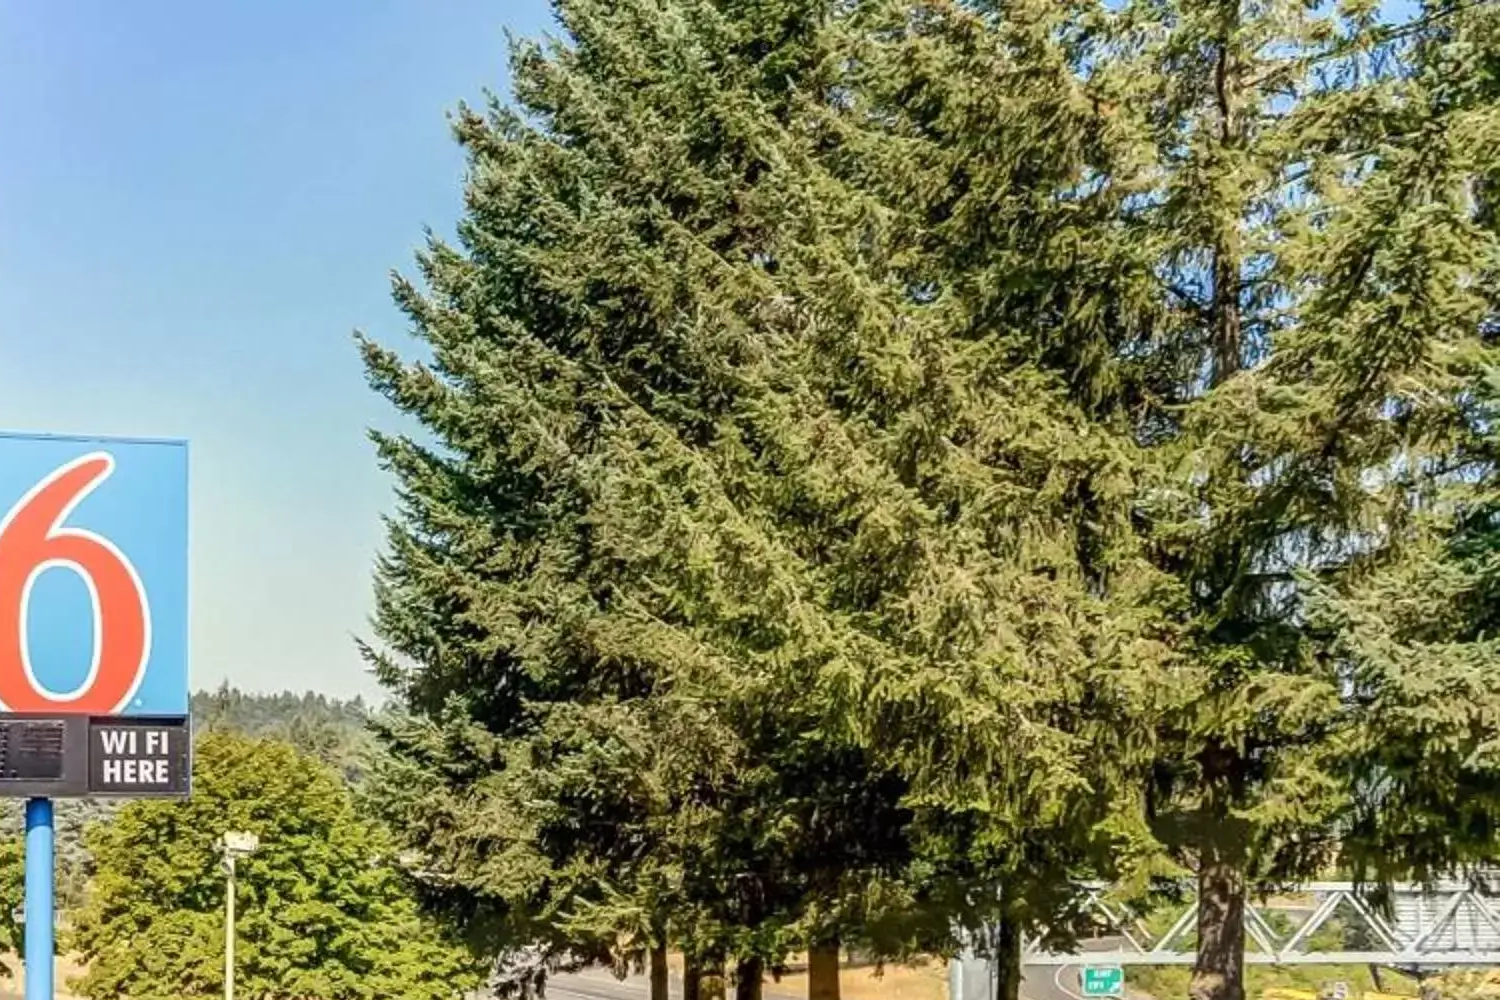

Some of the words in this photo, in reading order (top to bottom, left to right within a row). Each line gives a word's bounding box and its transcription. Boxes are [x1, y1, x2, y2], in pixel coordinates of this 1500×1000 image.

[101, 731, 137, 755] WI
[146, 731, 169, 755] FI
[103, 759, 169, 784] HERE
